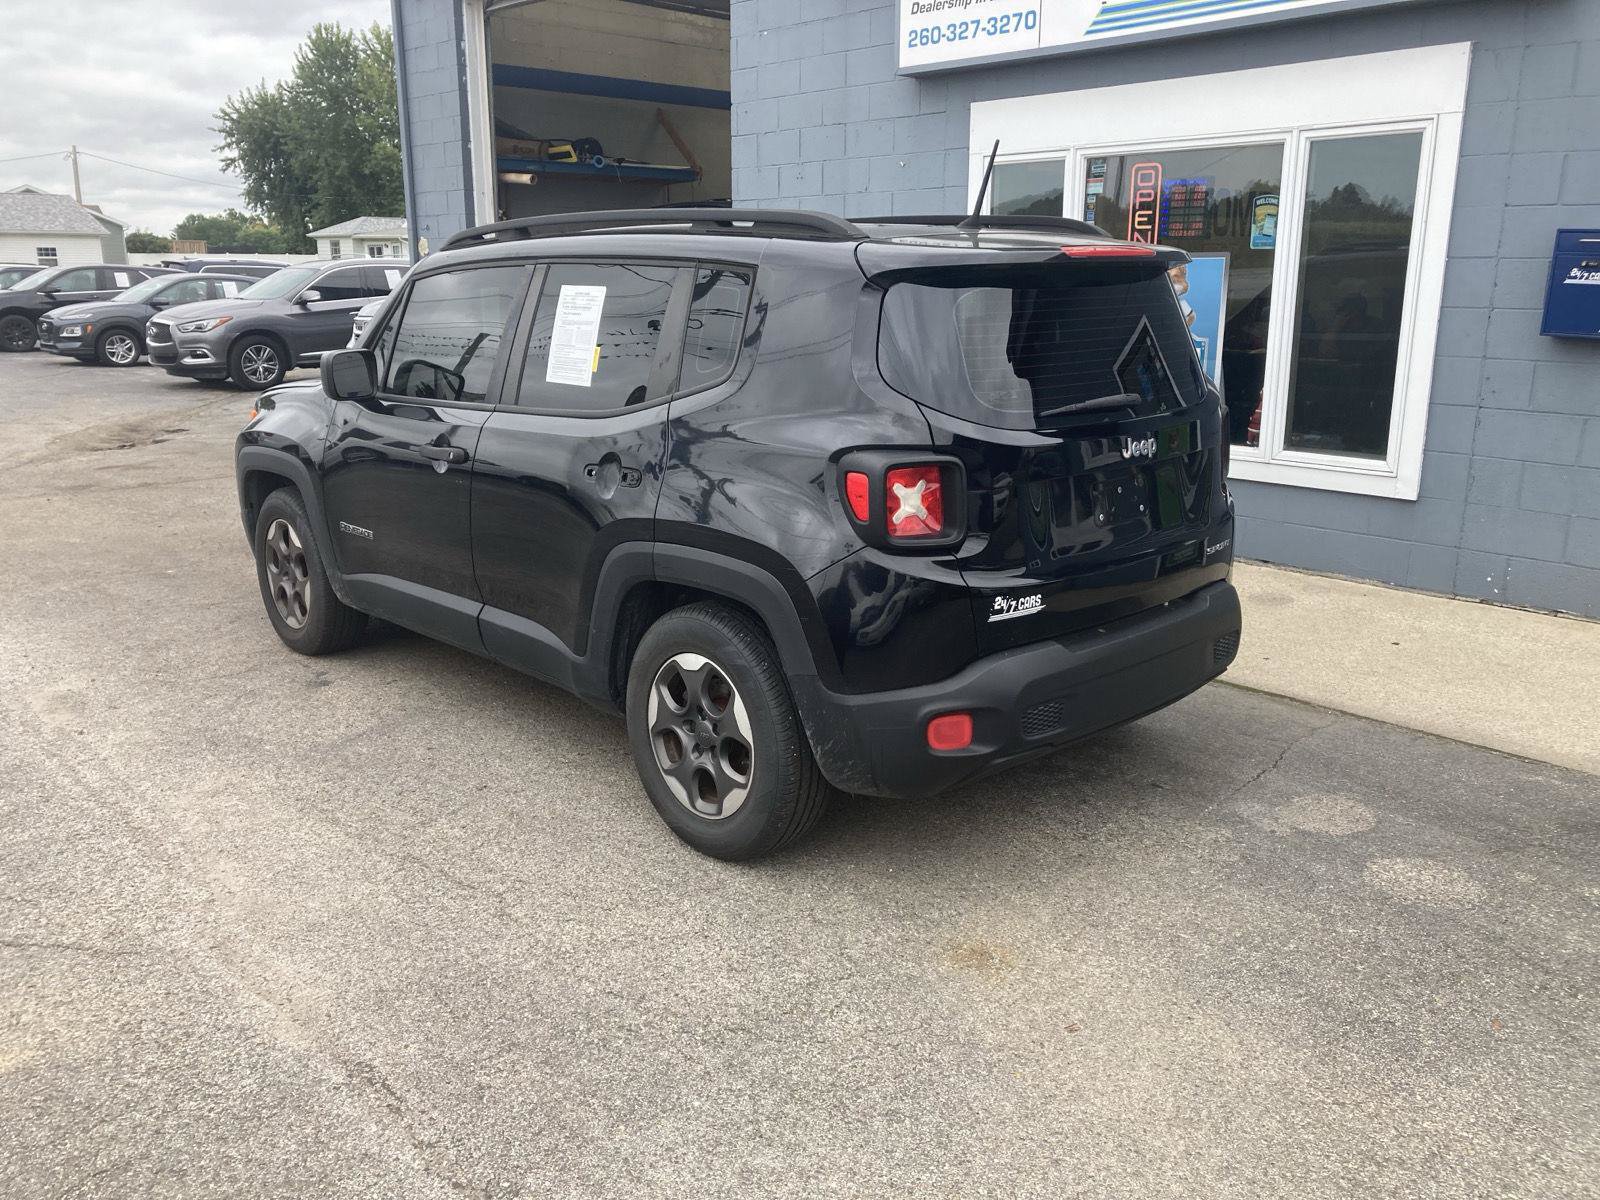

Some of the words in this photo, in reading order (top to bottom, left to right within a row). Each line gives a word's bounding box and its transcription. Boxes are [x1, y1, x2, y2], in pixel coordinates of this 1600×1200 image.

[911, 0, 971, 15] Dealership
[908, 9, 1037, 48] 260-327-3270
[1133, 169, 1155, 245] OPEN
[1570, 268, 1590, 280] 24/7
[1121, 437, 1157, 458] Jeep
[993, 596, 1017, 614] 24/7
[1018, 594, 1042, 610] CARS
